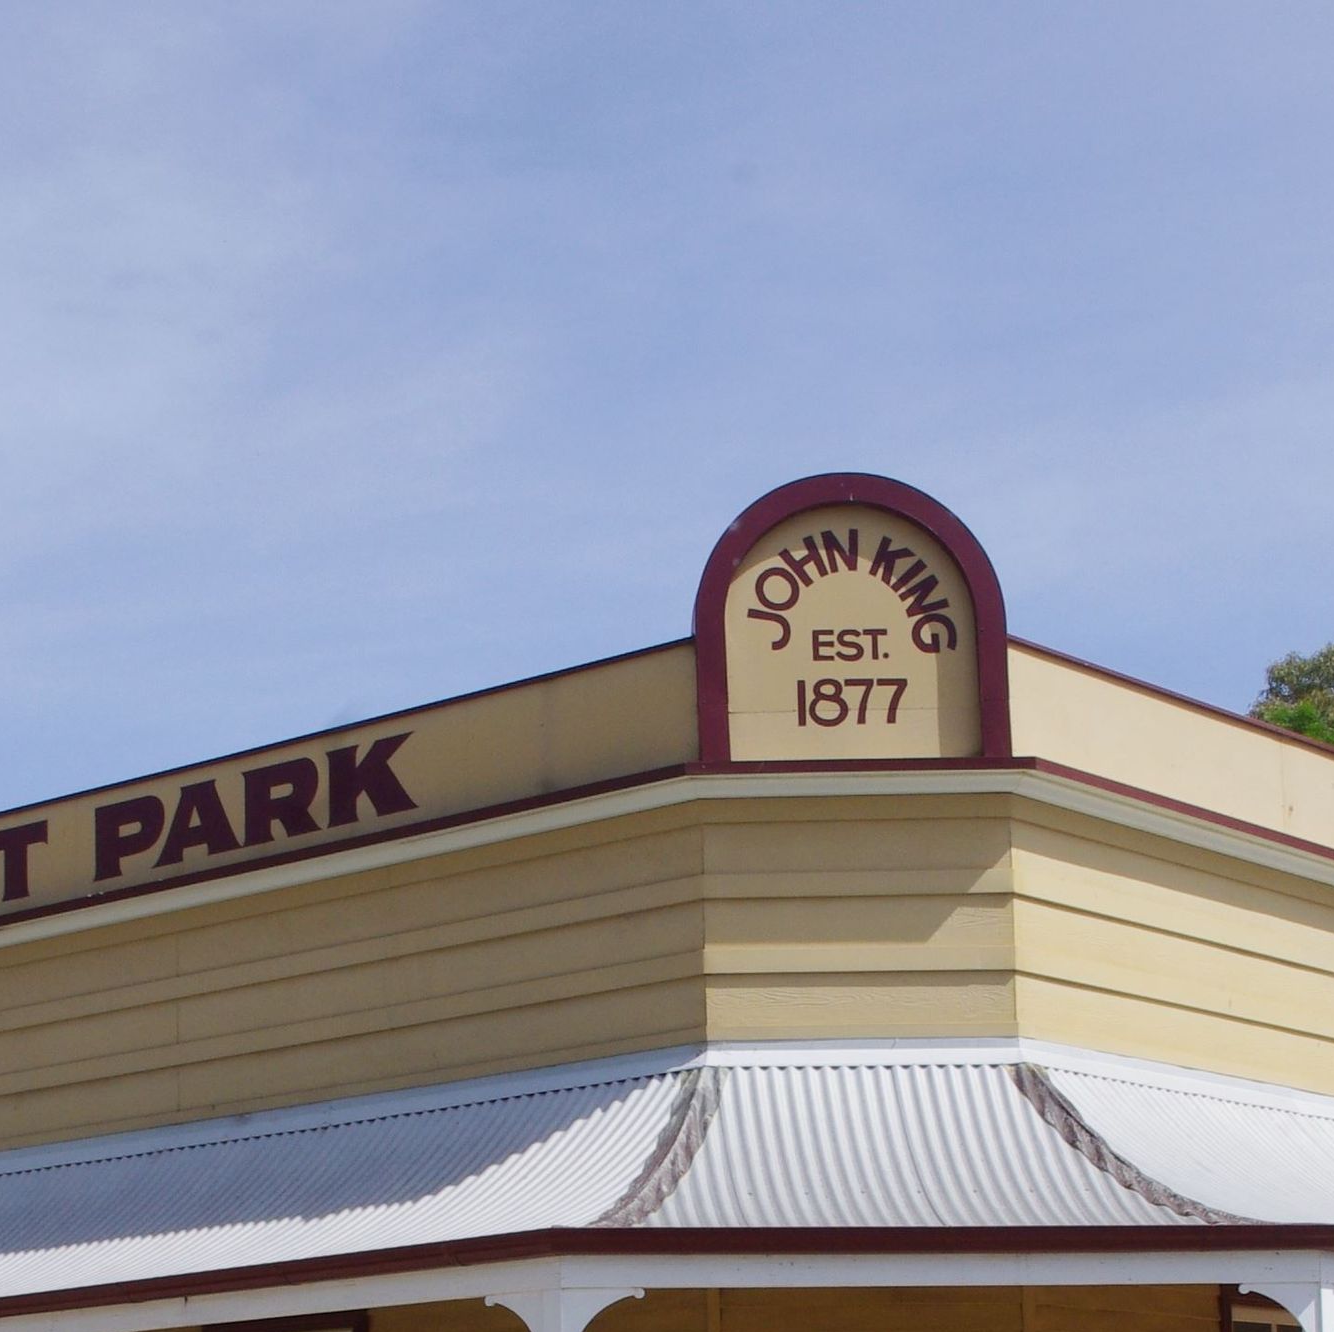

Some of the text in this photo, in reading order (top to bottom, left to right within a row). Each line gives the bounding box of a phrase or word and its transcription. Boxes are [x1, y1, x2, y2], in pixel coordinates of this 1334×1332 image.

[747, 528, 957, 654] JOHN KING
[812, 628, 890, 662] EST.
[797, 678, 908, 727] 1877
[93, 731, 419, 883] PARK
